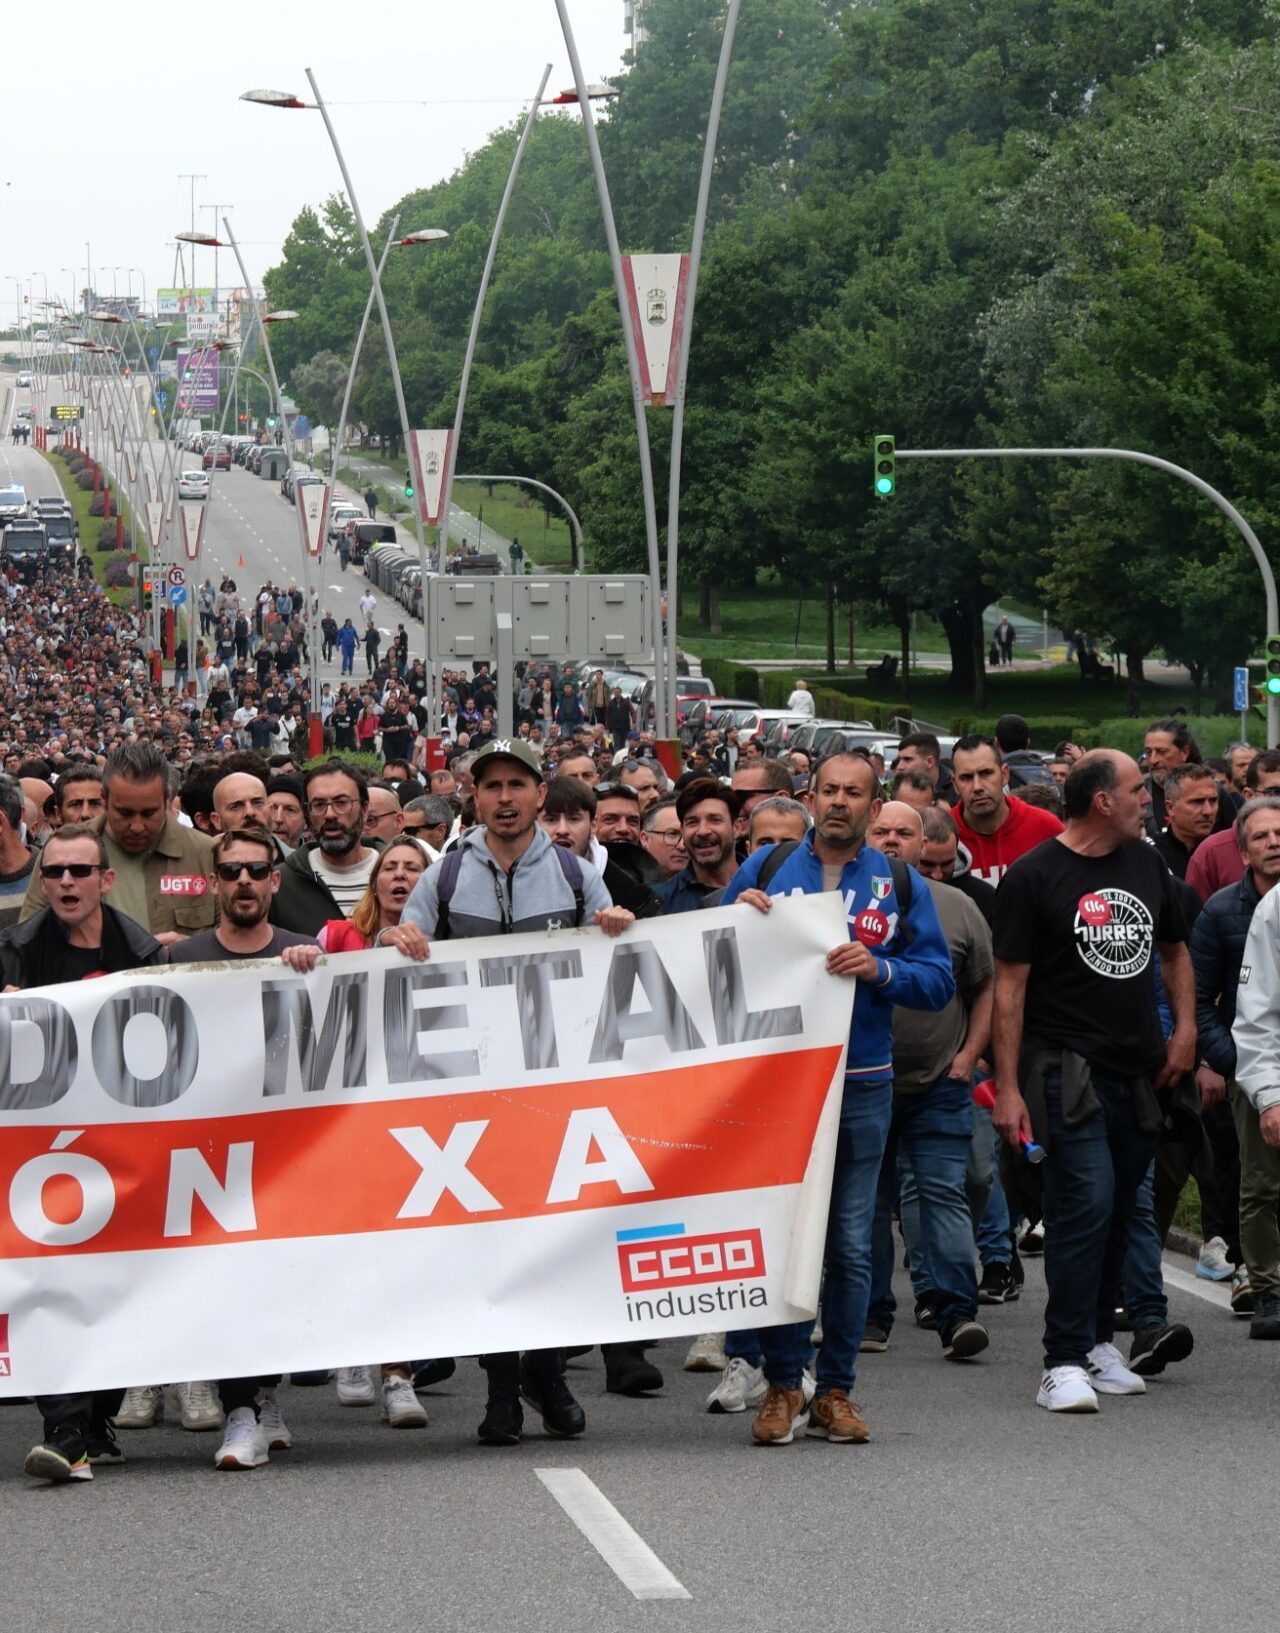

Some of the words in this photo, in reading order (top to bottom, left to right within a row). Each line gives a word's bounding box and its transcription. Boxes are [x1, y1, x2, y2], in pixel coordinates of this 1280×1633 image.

[160, 878, 192, 892] UGT
[1085, 949, 1113, 973] DANDO
[1114, 948, 1149, 974] ZAPATILLA
[261, 925, 804, 1097] METAL
[628, 1239, 755, 1283] CCOO
[625, 1282, 768, 1322] industria
